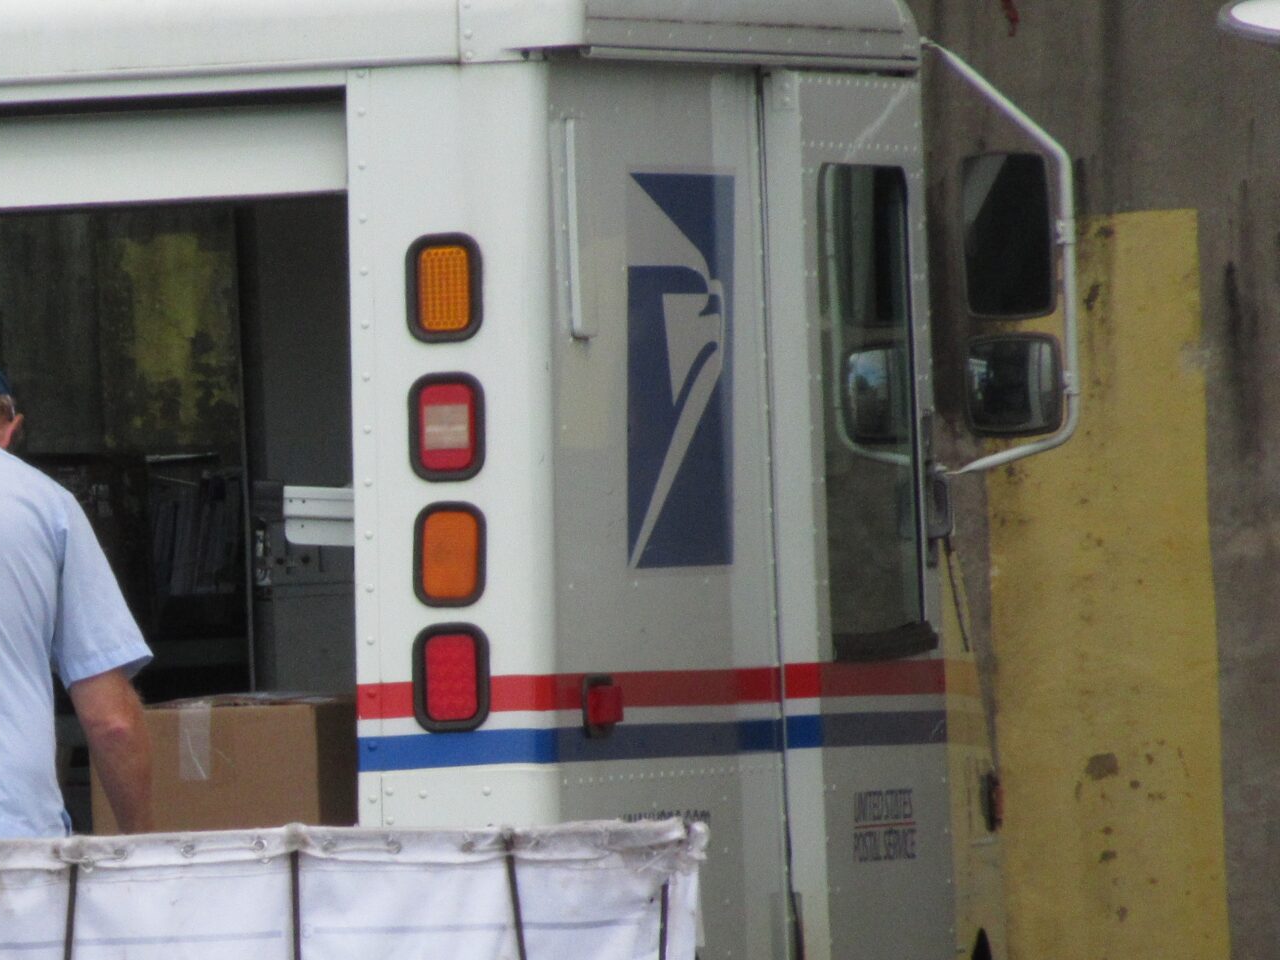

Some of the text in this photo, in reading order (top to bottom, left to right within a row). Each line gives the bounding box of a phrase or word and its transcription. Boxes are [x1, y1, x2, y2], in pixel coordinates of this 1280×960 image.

[854, 787, 913, 822] UNITED STATES
[853, 828, 917, 862] POSTAL SERVICE
